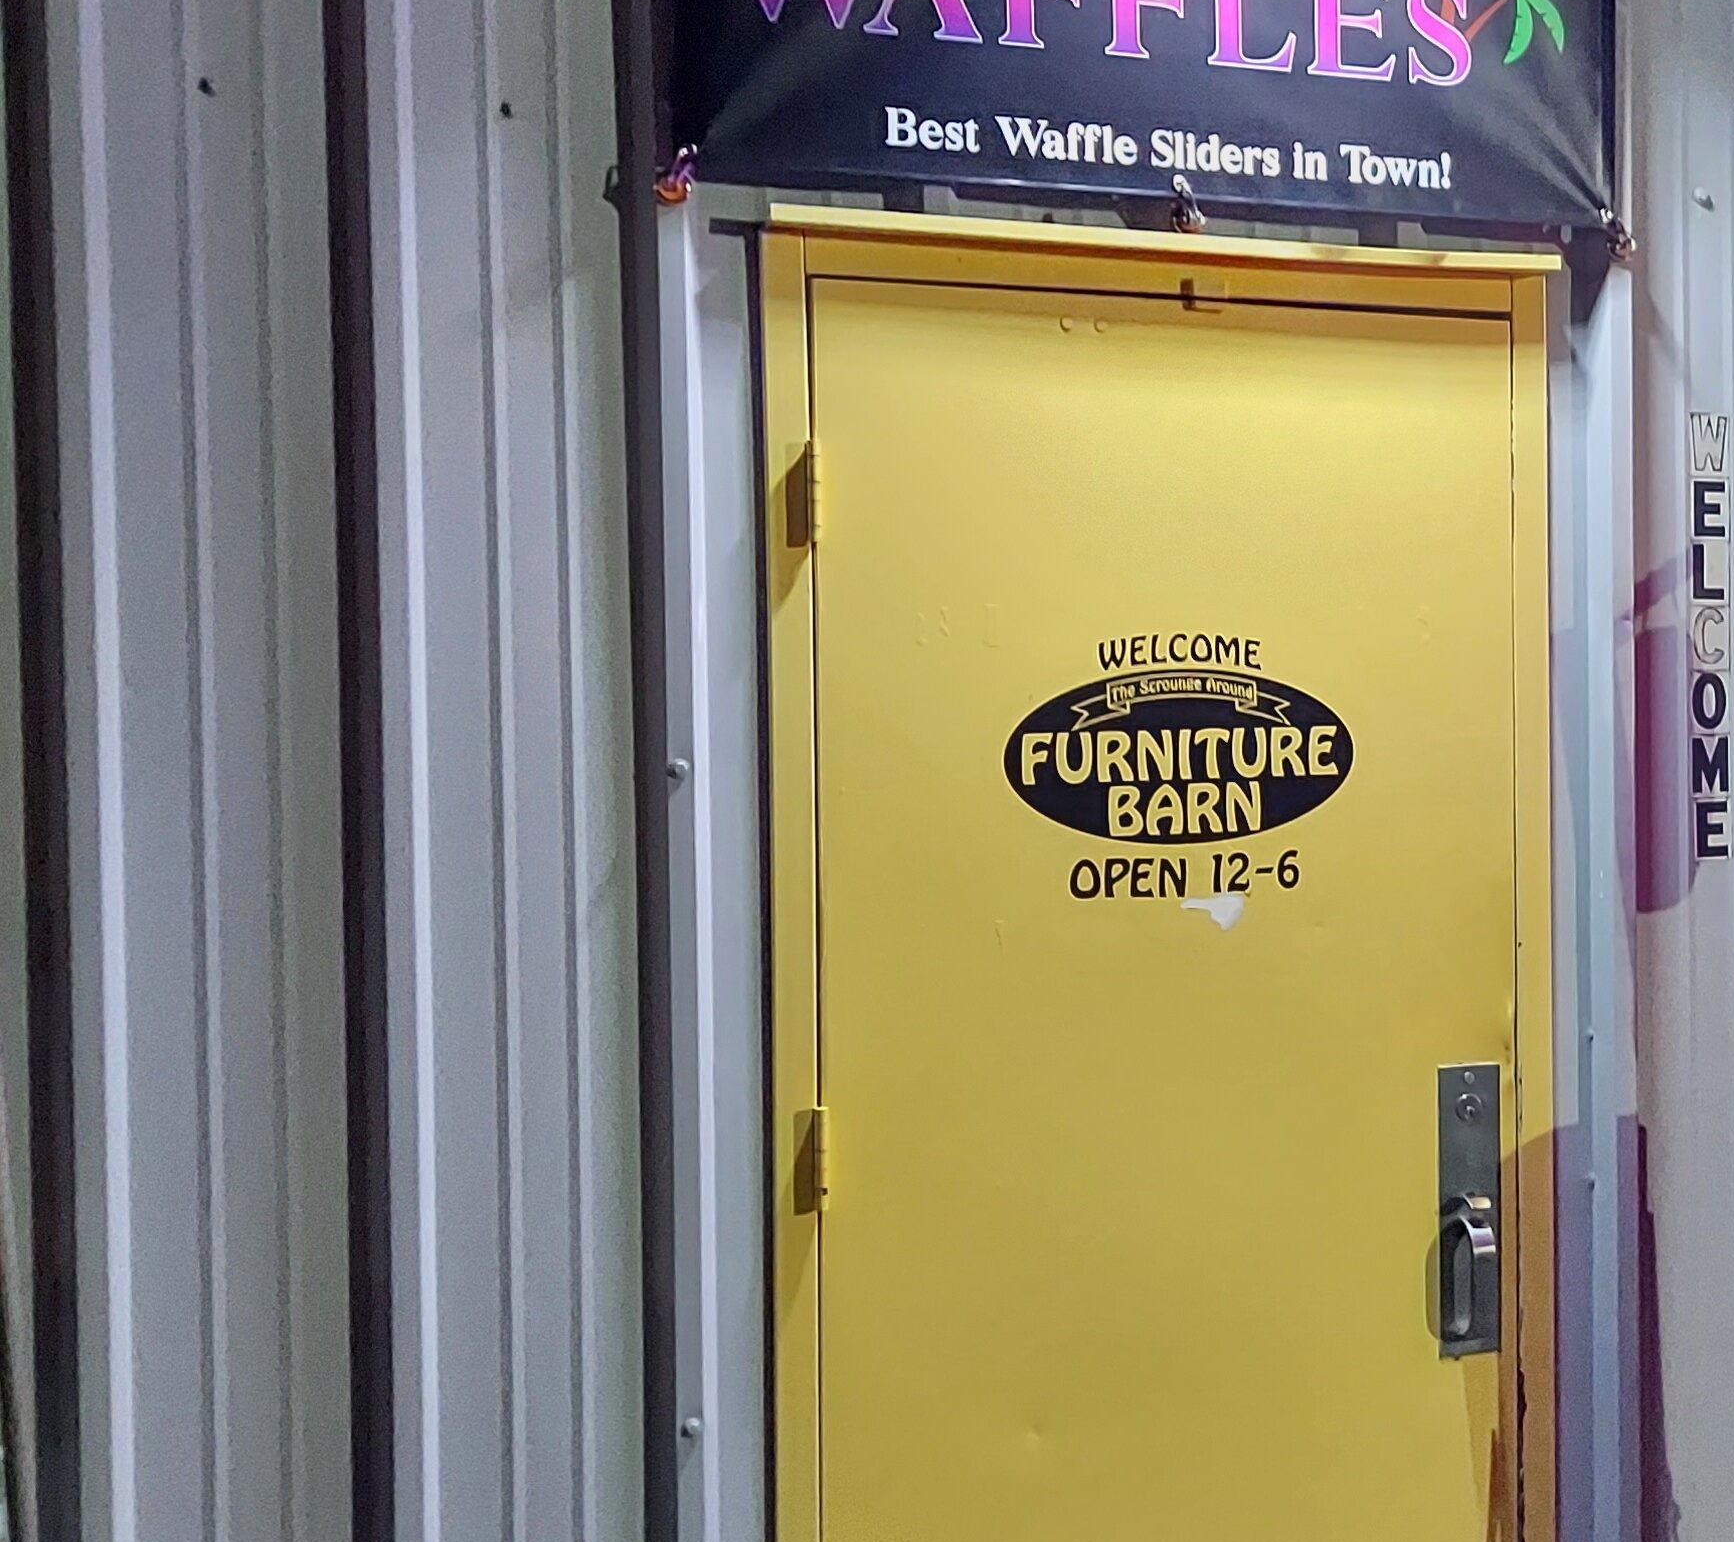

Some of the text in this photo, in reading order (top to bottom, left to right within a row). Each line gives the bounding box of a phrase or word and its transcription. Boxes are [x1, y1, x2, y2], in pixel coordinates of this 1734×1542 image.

[885, 107, 1452, 190] Best Waffle Sliders in Town!
[1098, 633, 1263, 671] WELCOME
[1690, 413, 1731, 858] WELCOME
[1111, 677, 1253, 702] The Scrounge Around
[1021, 725, 1339, 786] FURNITURE
[1108, 781, 1261, 837] BARN
[1070, 850, 1300, 899] OPEN 12-6
